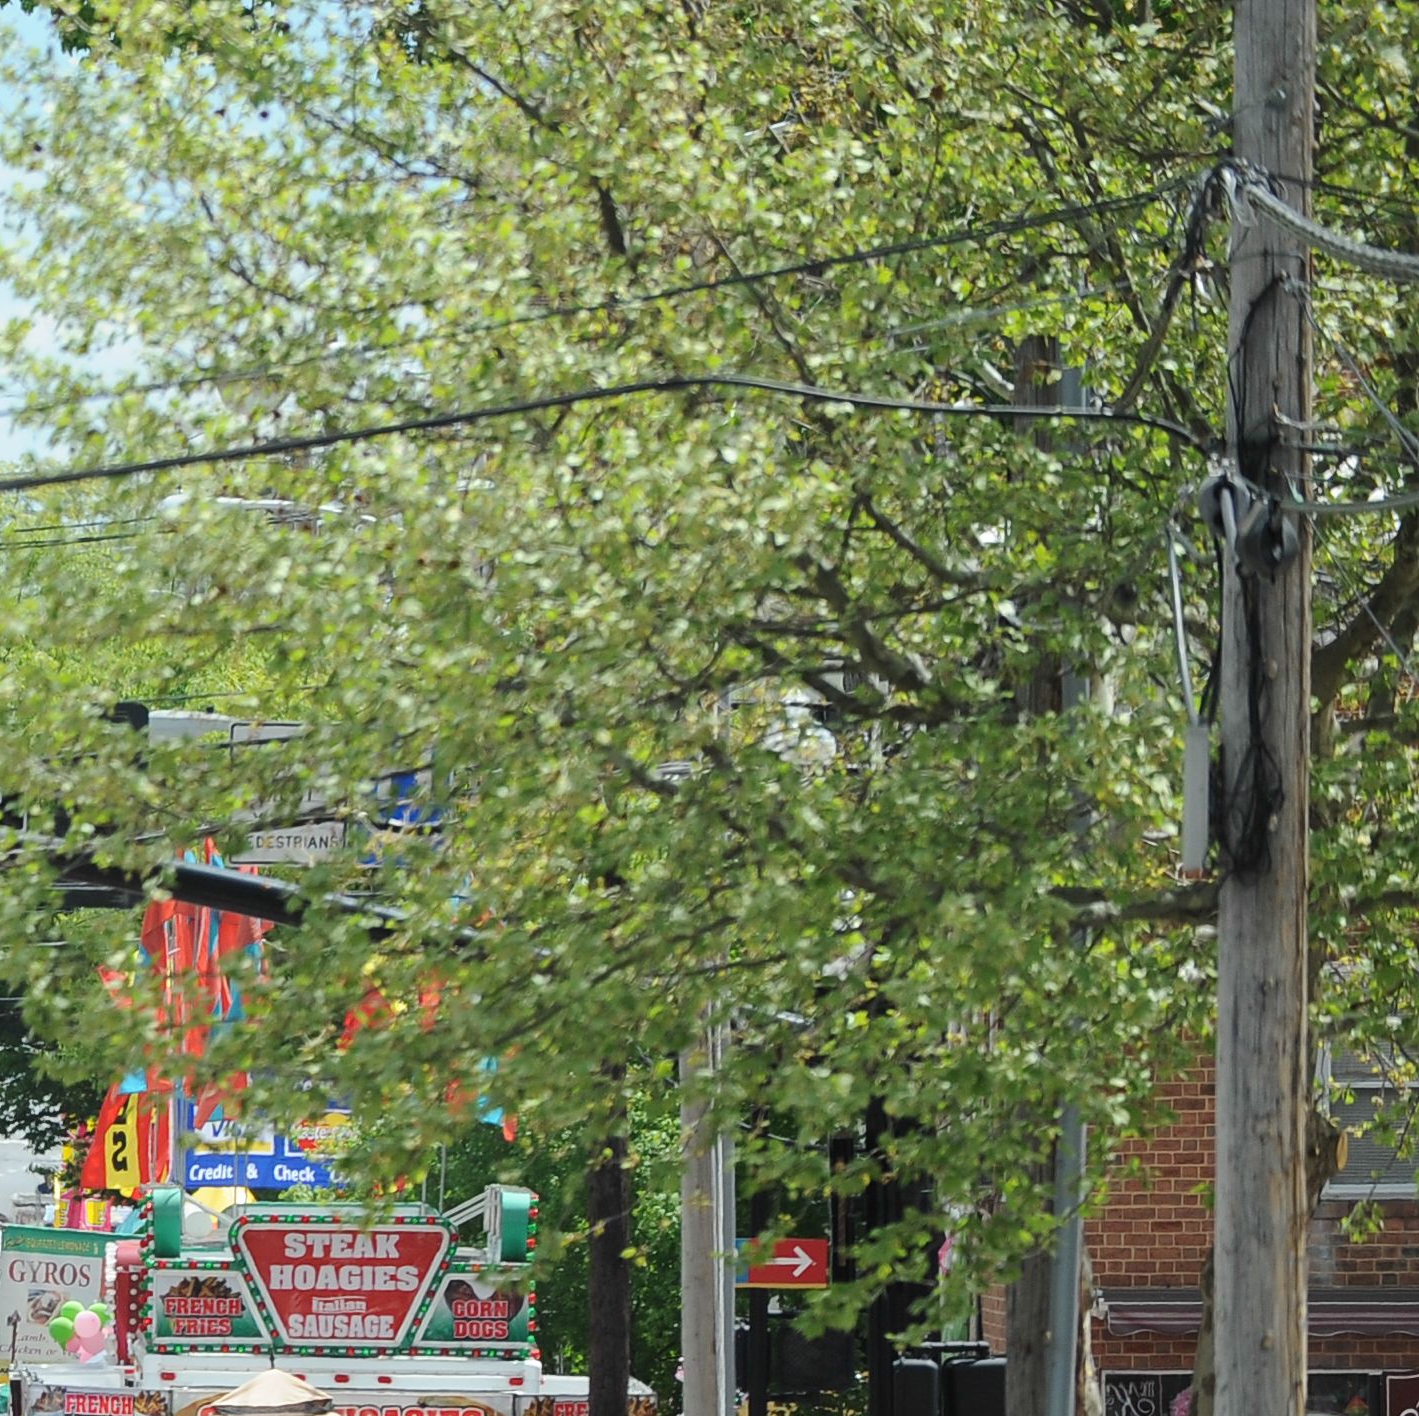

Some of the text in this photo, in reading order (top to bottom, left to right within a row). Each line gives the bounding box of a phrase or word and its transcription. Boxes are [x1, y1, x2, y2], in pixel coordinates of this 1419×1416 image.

[248, 836, 345, 849] EDESTRIANS
[189, 1163, 234, 1181] Credit
[246, 1163, 258, 1179] &
[274, 1164, 315, 1182] Check
[284, 1233, 400, 1259] STEAK
[8, 1259, 91, 1288] GYROS
[269, 1265, 420, 1291] HOAGIES
[164, 1298, 242, 1316] FRENCH
[312, 1297, 367, 1312] Italian
[453, 1300, 508, 1318] CORN
[288, 1314, 394, 1339] SAUSAGE
[453, 1320, 508, 1339] DOGS
[64, 1392, 134, 1416] FRENCH
